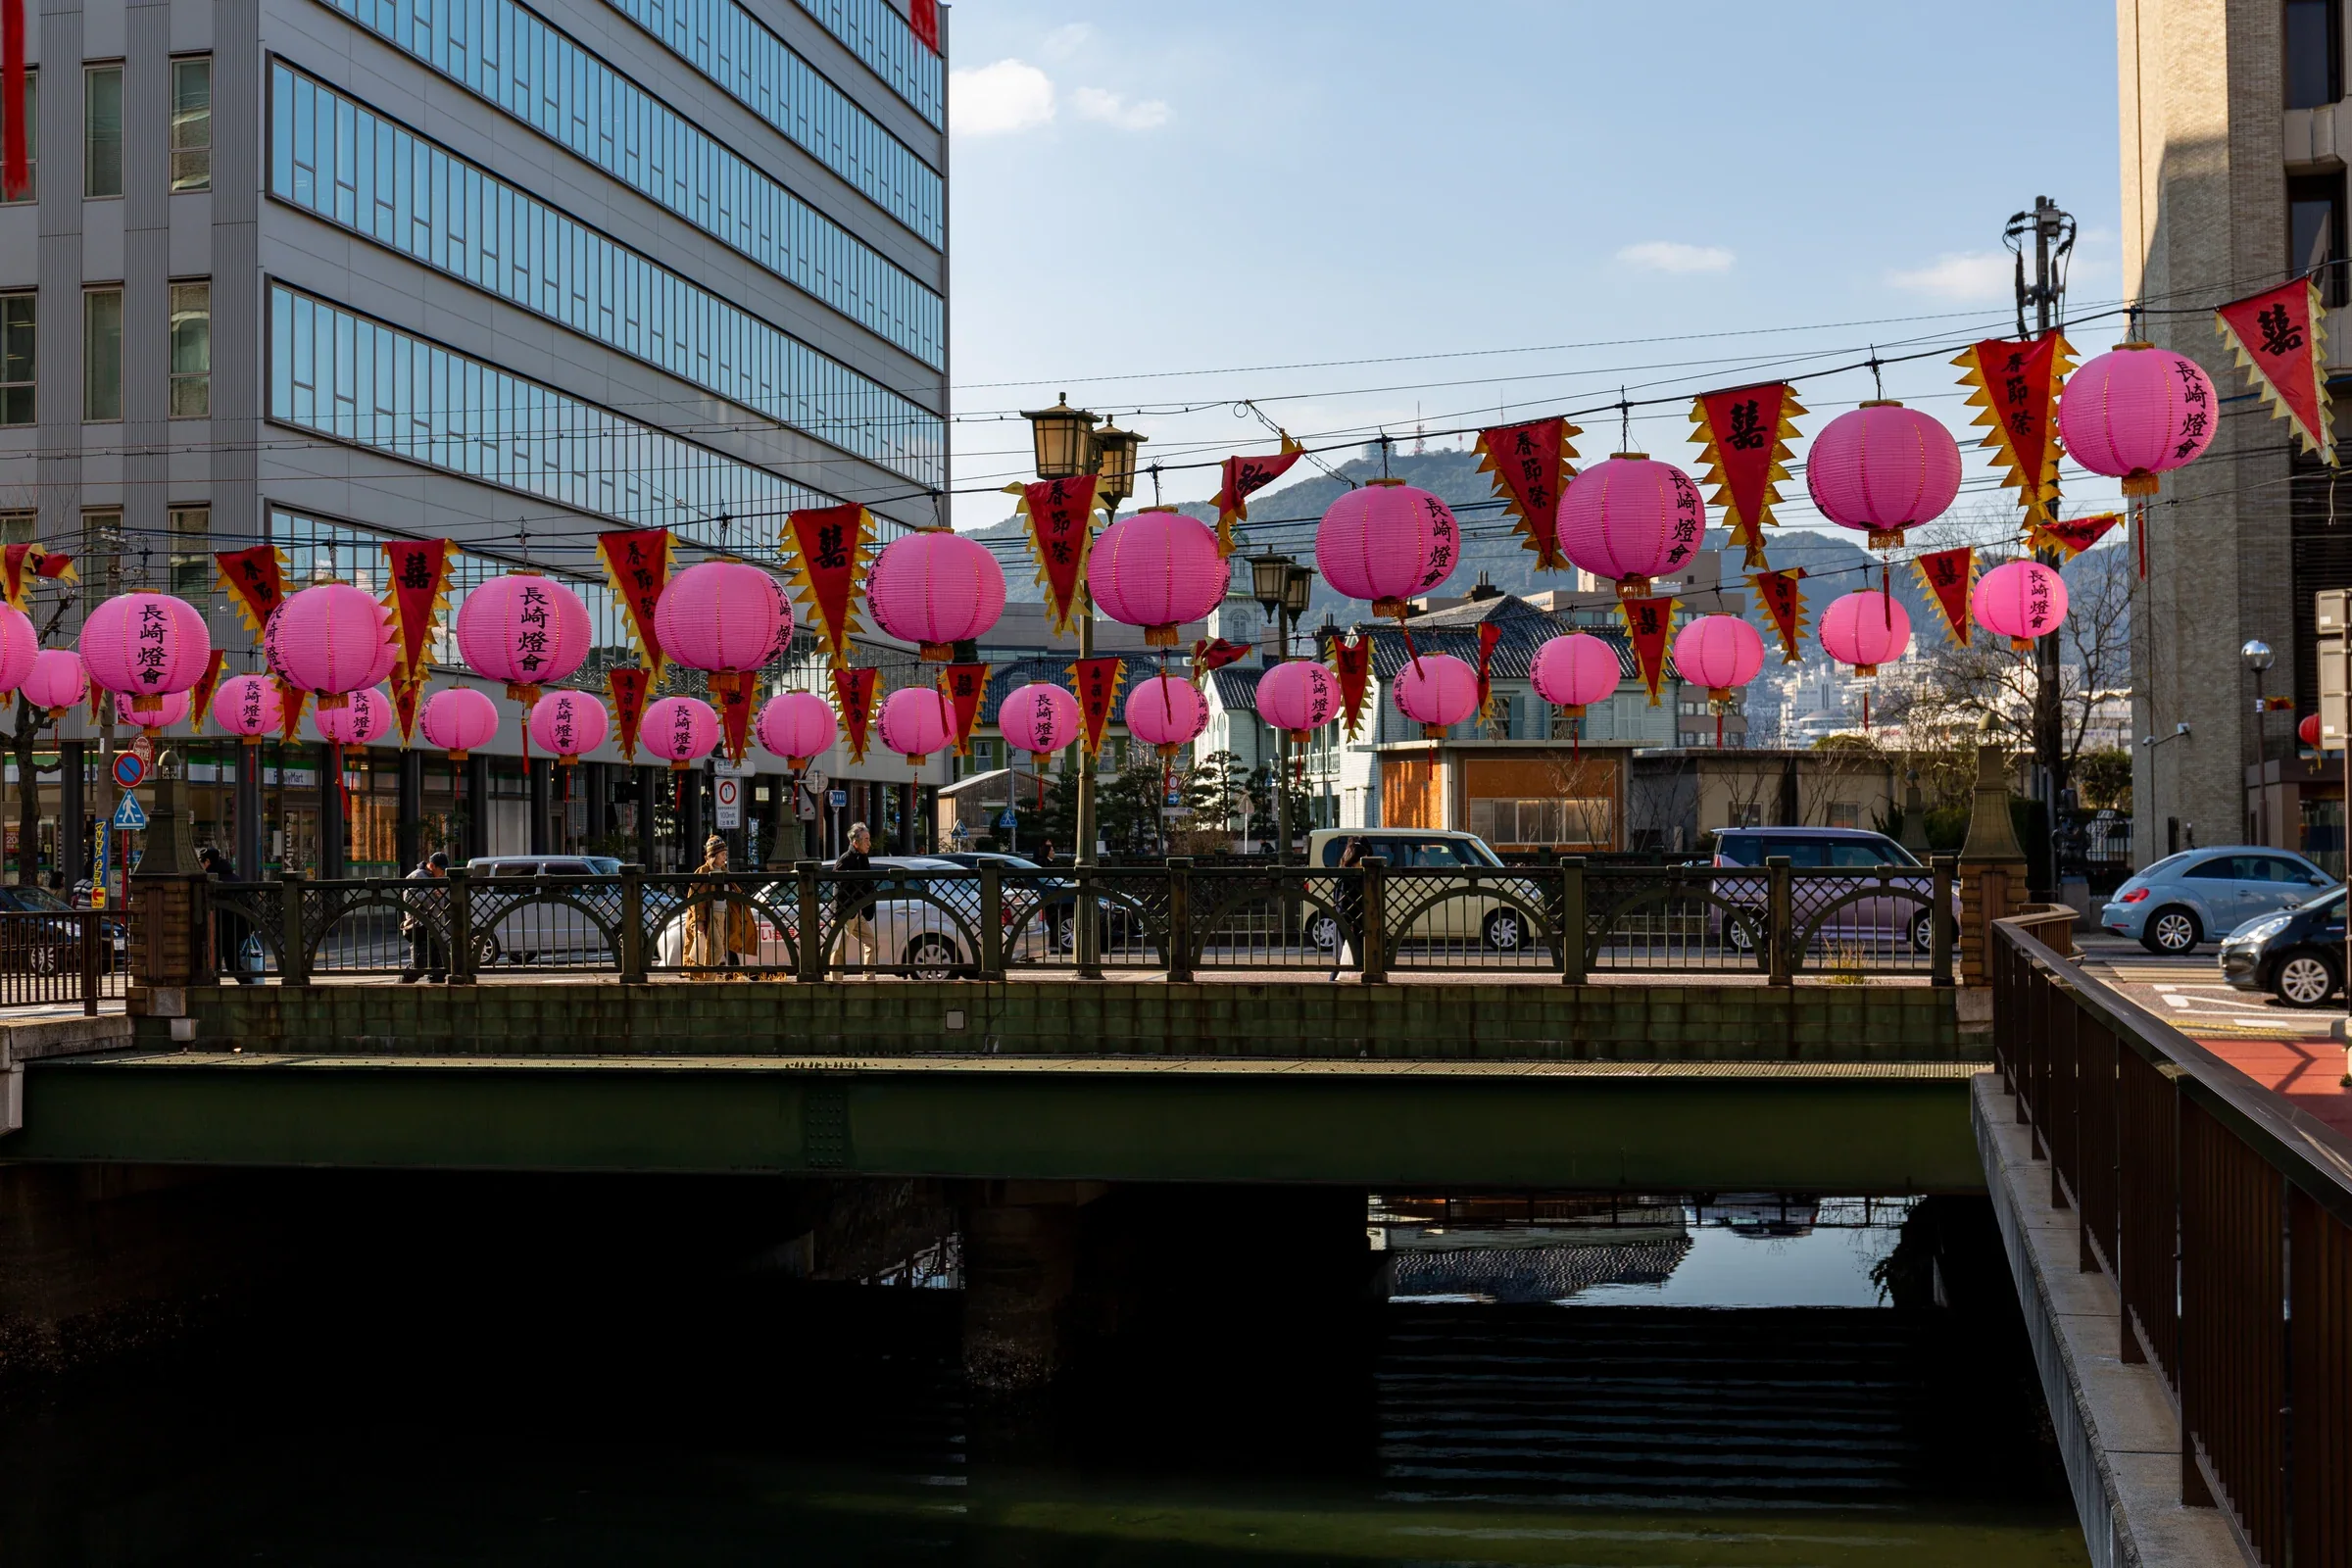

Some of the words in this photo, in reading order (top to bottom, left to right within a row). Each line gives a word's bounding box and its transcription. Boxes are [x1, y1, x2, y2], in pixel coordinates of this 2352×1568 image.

[2001, 352, 2035, 436] 春節祭
[2175, 361, 2207, 459] 長崎燈會
[1515, 431, 1550, 509] 春節祭
[1046, 480, 1072, 564] 春節祭
[1421, 498, 1452, 587] 長崎燈會
[1667, 470, 1697, 565] 長崎燈會
[625, 541, 655, 619] 春節祭
[2030, 569, 2049, 629] 長崎燈會
[137, 605, 168, 684] 長崎燈會
[517, 587, 549, 671] 長崎燈會
[244, 681, 261, 727] 長崎燈會
[353, 692, 370, 738] 長崎燈會
[555, 698, 573, 748] 長崎燈會
[673, 705, 692, 756] 長崎燈會
[1035, 694, 1054, 747] 長崎燈會
[1311, 669, 1329, 723] 長崎燈會
